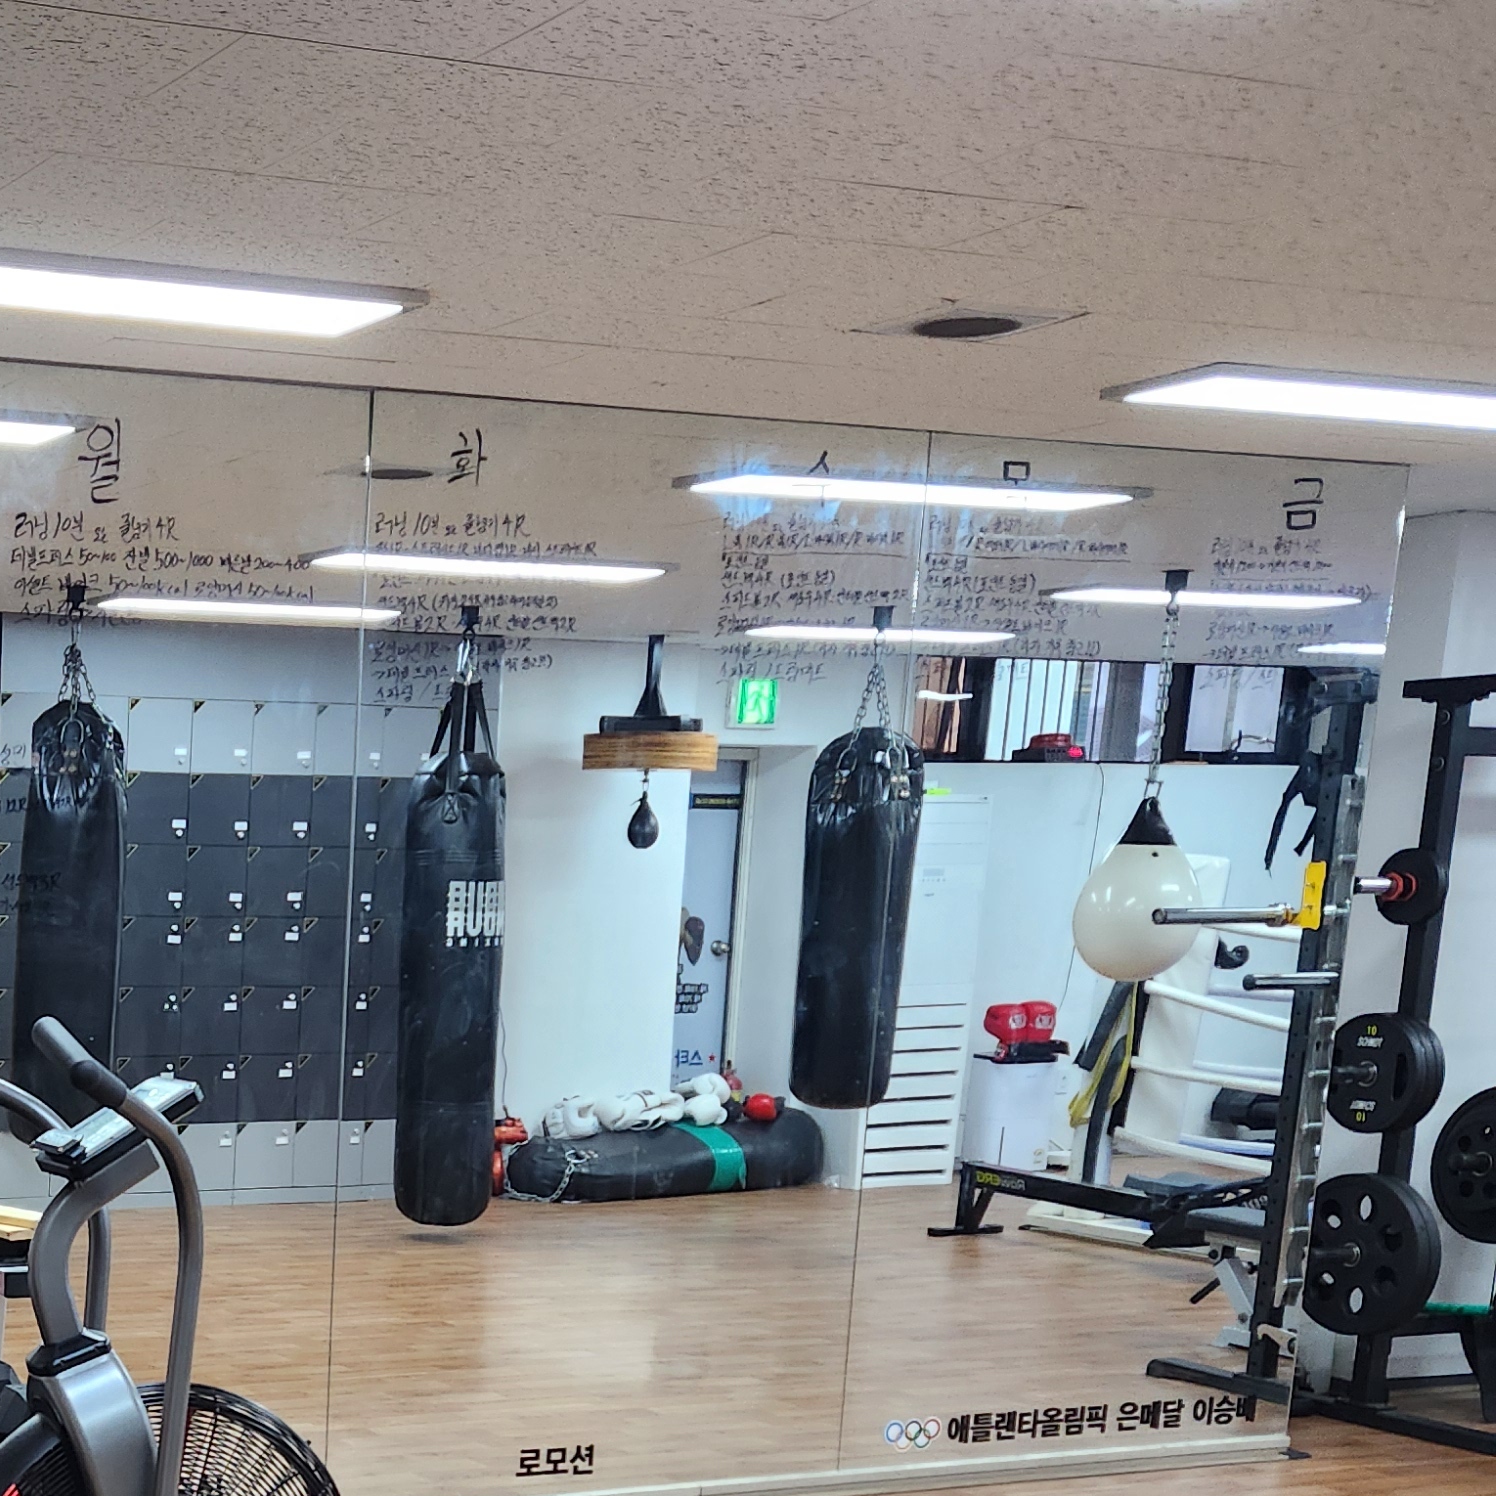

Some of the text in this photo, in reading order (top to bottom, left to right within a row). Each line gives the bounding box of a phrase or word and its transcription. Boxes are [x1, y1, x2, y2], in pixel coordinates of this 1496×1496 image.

[79, 417, 122, 504] 월
[447, 427, 488, 486] 화
[1282, 477, 1324, 531] 금
[1116, 1398, 1185, 1432] 은메달
[516, 1444, 594, 1477] 로모션
